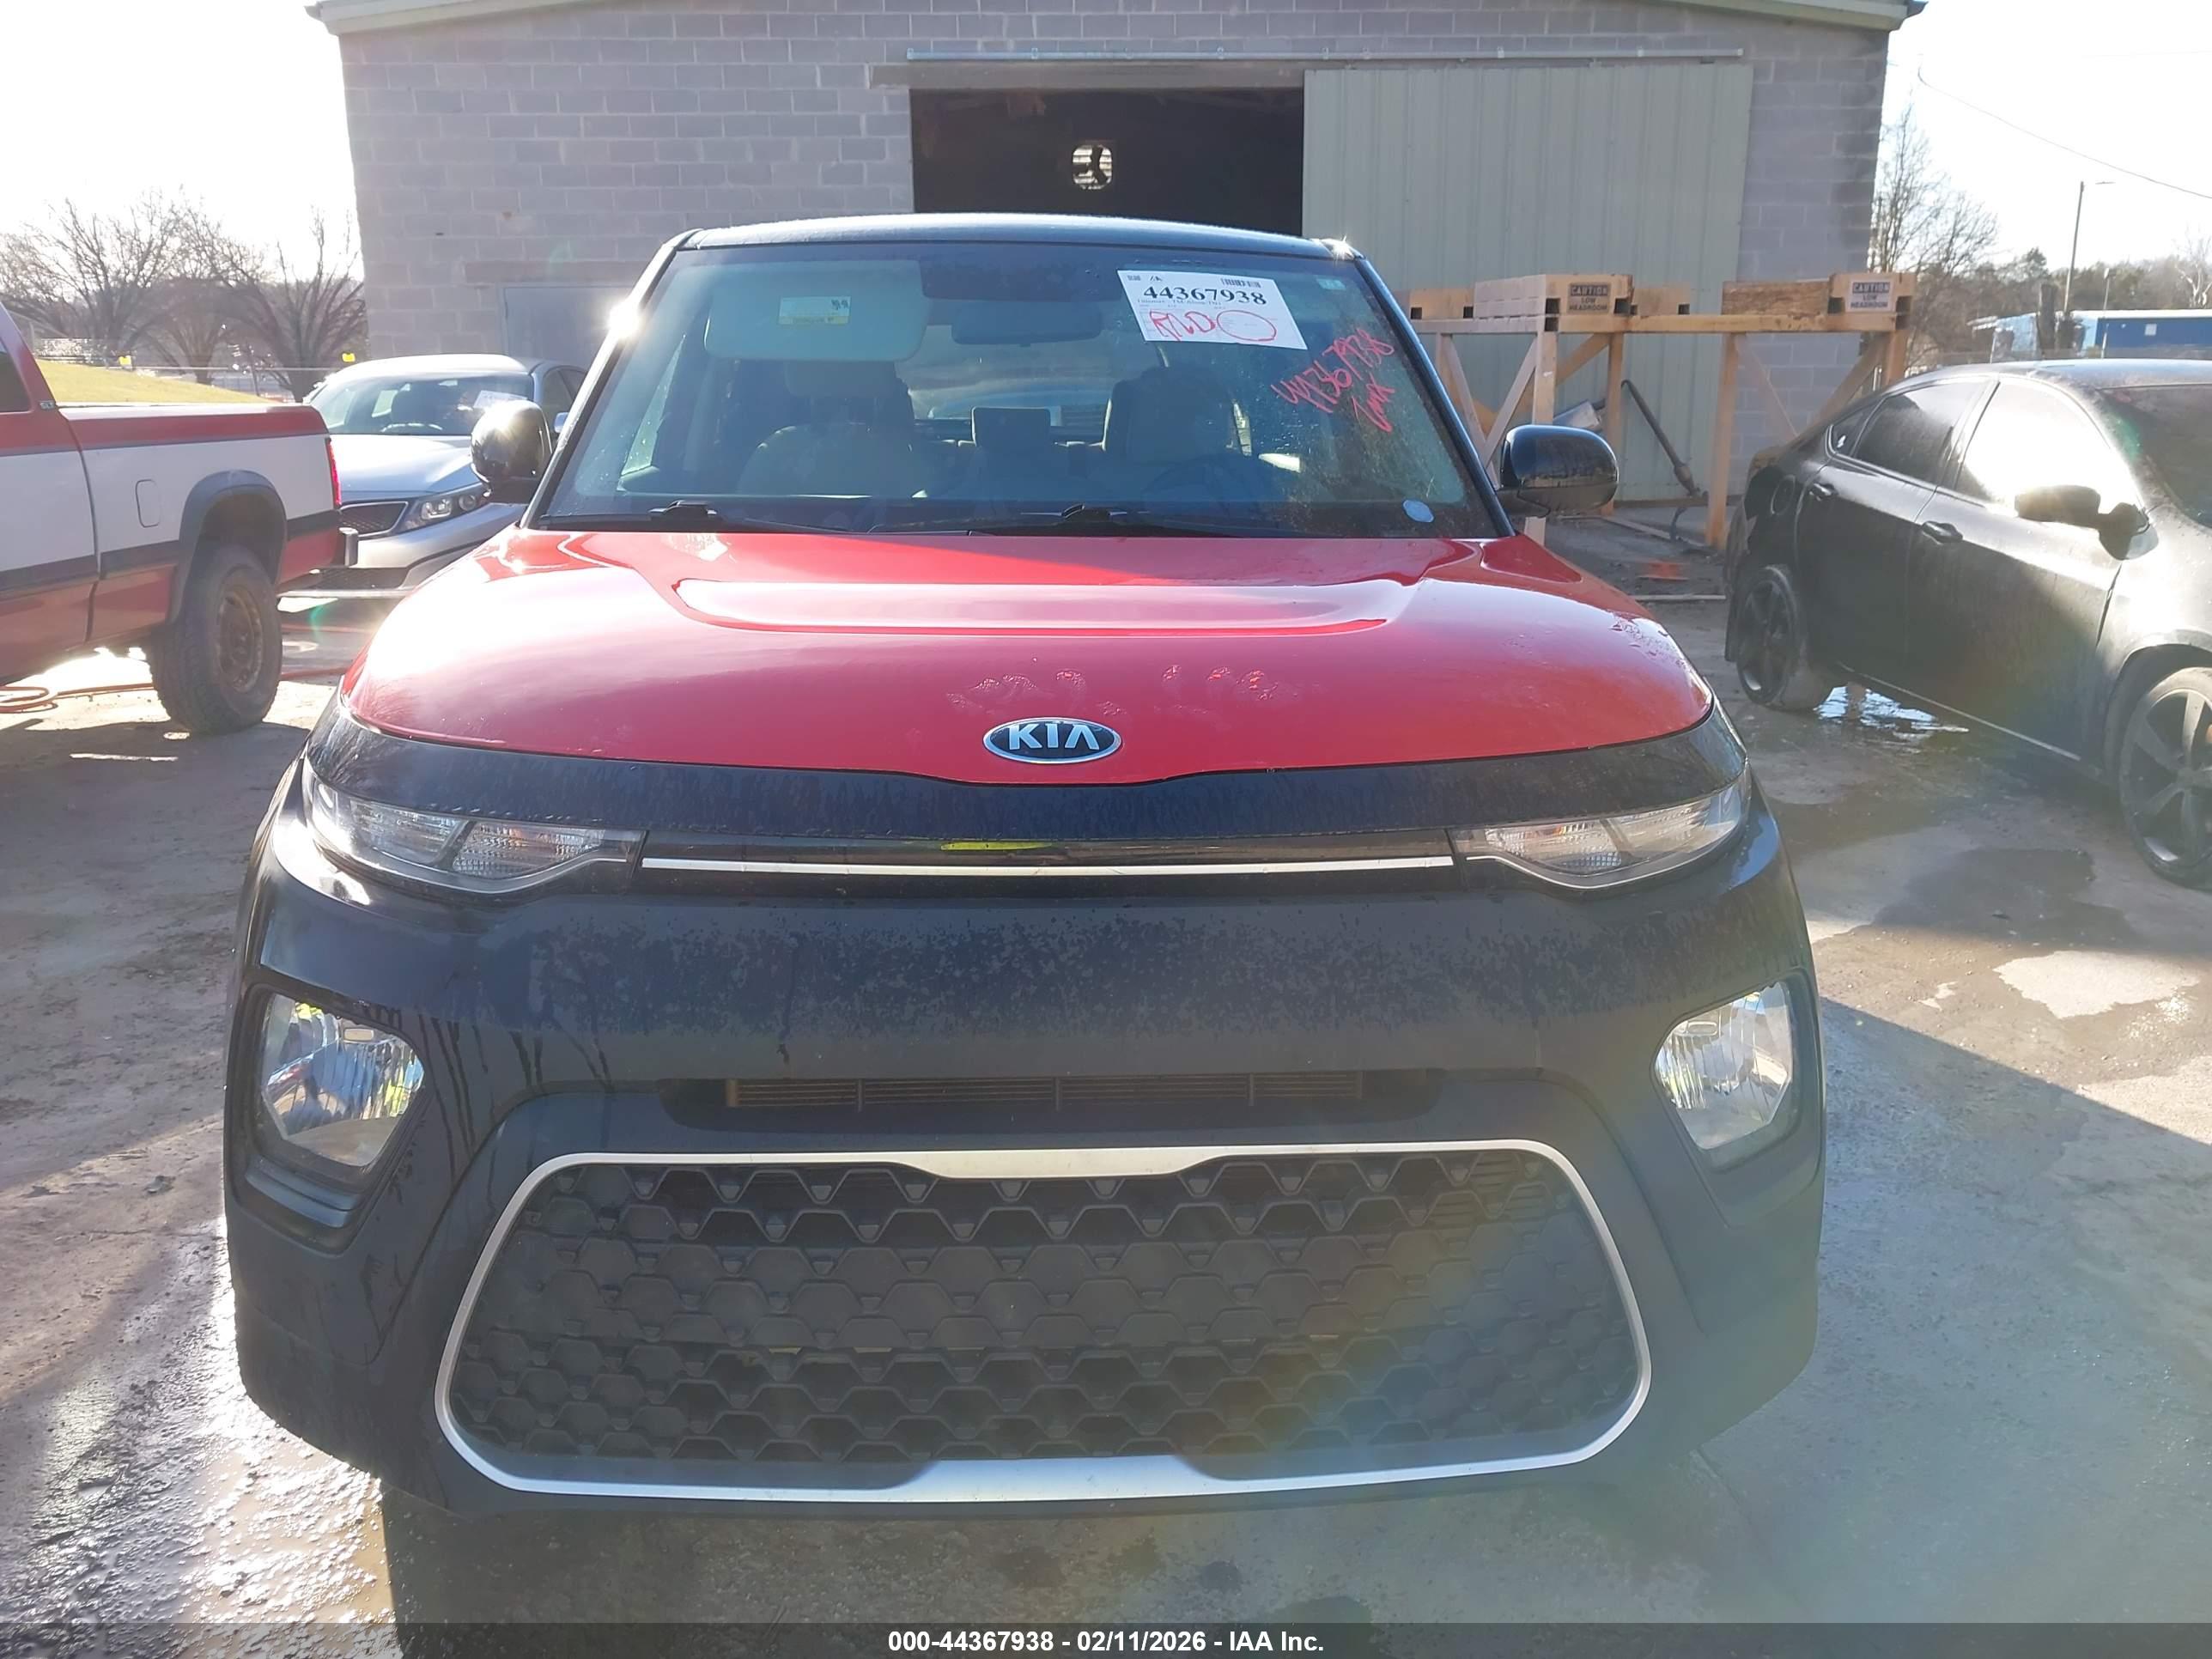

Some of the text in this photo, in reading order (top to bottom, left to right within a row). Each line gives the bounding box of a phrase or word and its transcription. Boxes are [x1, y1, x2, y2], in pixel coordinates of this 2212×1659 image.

[1571, 285, 1608, 295] CAUTION
[1852, 283, 1890, 293] CAUTION
[1143, 286, 1267, 305] 44367938
[1008, 723, 1100, 750] KIA
